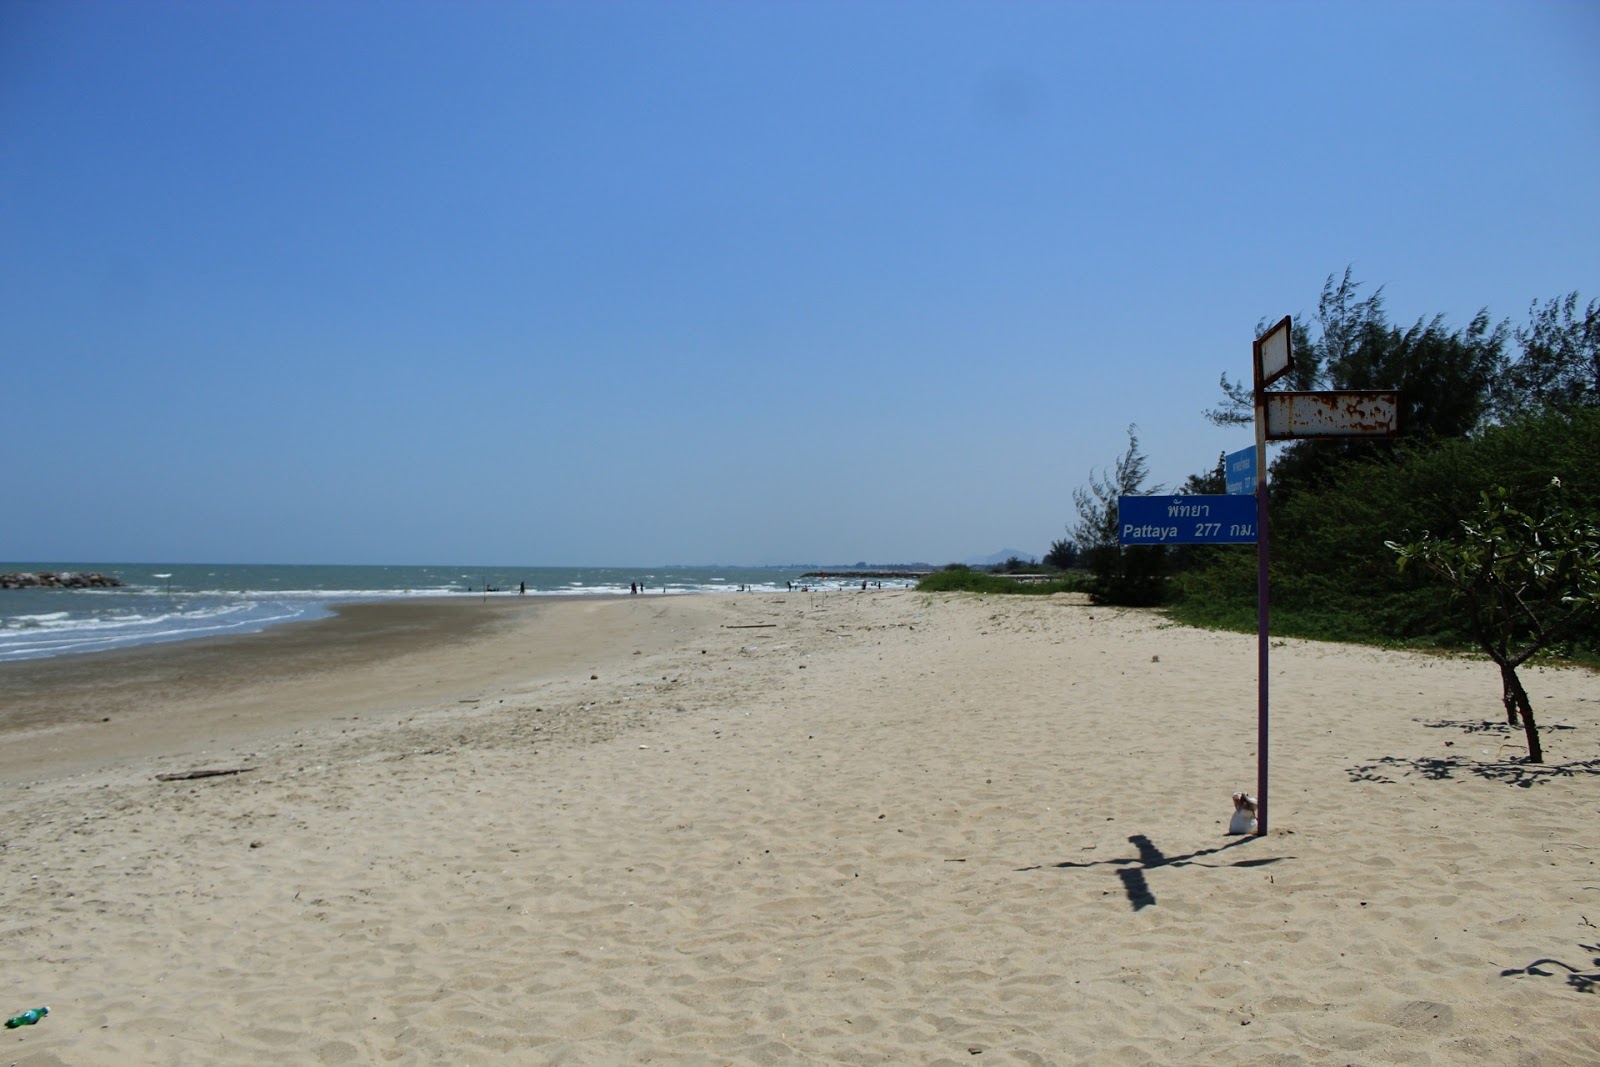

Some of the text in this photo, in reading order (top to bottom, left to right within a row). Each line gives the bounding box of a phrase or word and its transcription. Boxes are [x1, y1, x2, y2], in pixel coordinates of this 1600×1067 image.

[1168, 499, 1210, 517] พัทยา
[1123, 523, 1256, 540] Pattaya 277 กม.
